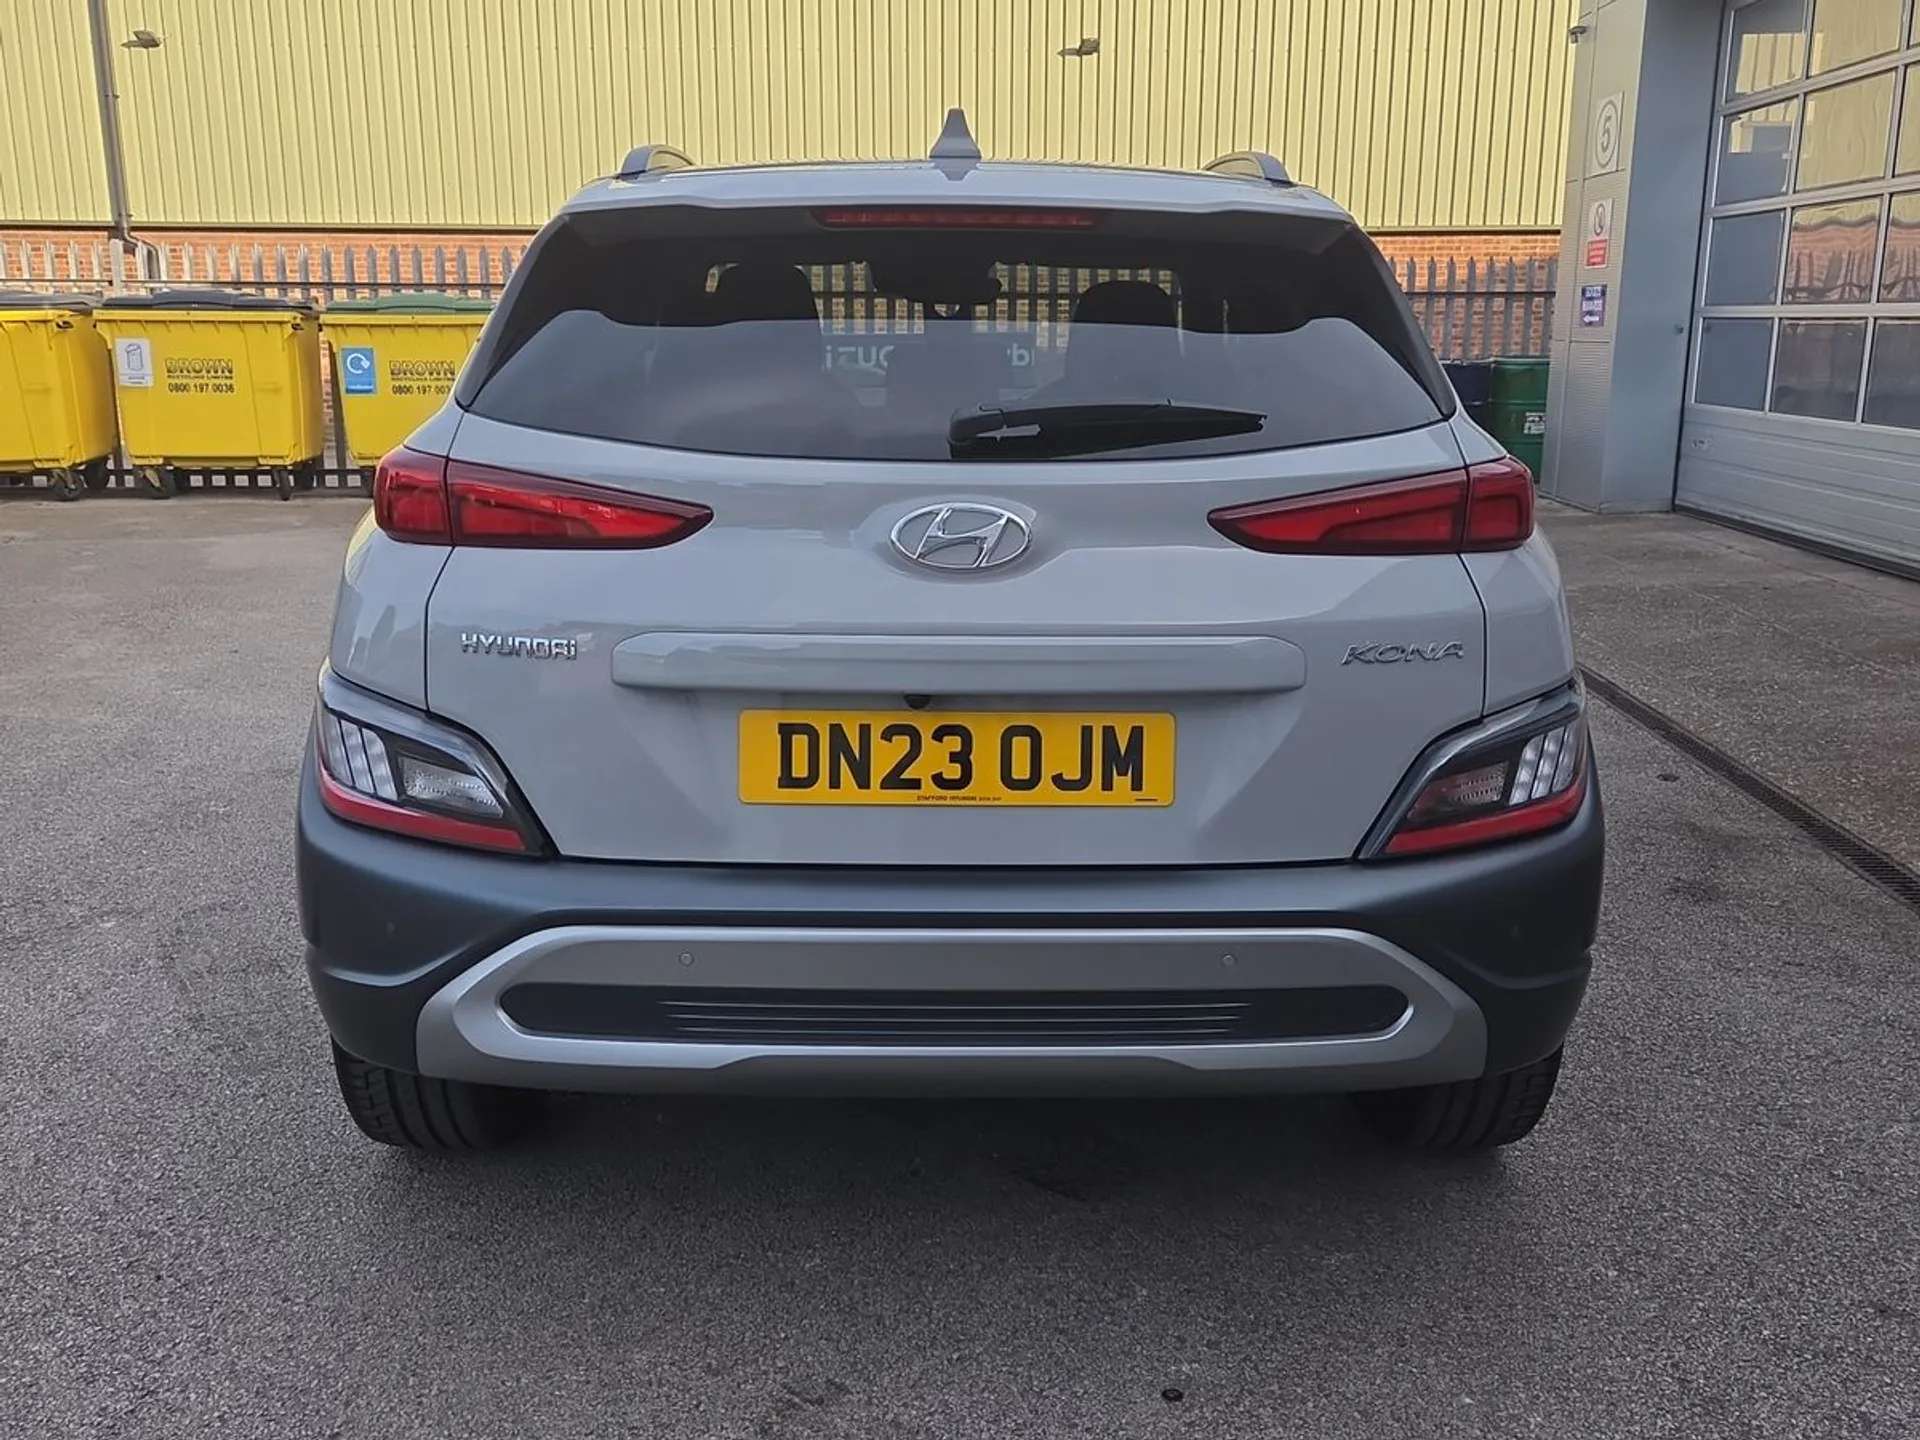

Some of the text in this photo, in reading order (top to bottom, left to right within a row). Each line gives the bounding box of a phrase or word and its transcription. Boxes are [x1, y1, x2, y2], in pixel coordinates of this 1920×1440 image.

[1601, 113, 1612, 153] 5
[165, 358, 233, 374] BROWN
[389, 360, 456, 376] BROWN
[168, 382, 190, 393] 0800
[193, 382, 209, 393] 197
[392, 384, 414, 395] 0800
[416, 384, 433, 395] 197
[461, 632, 577, 660] HYUNDAI
[1341, 641, 1464, 665] KONA
[777, 722, 1144, 792] DN23 OJM
